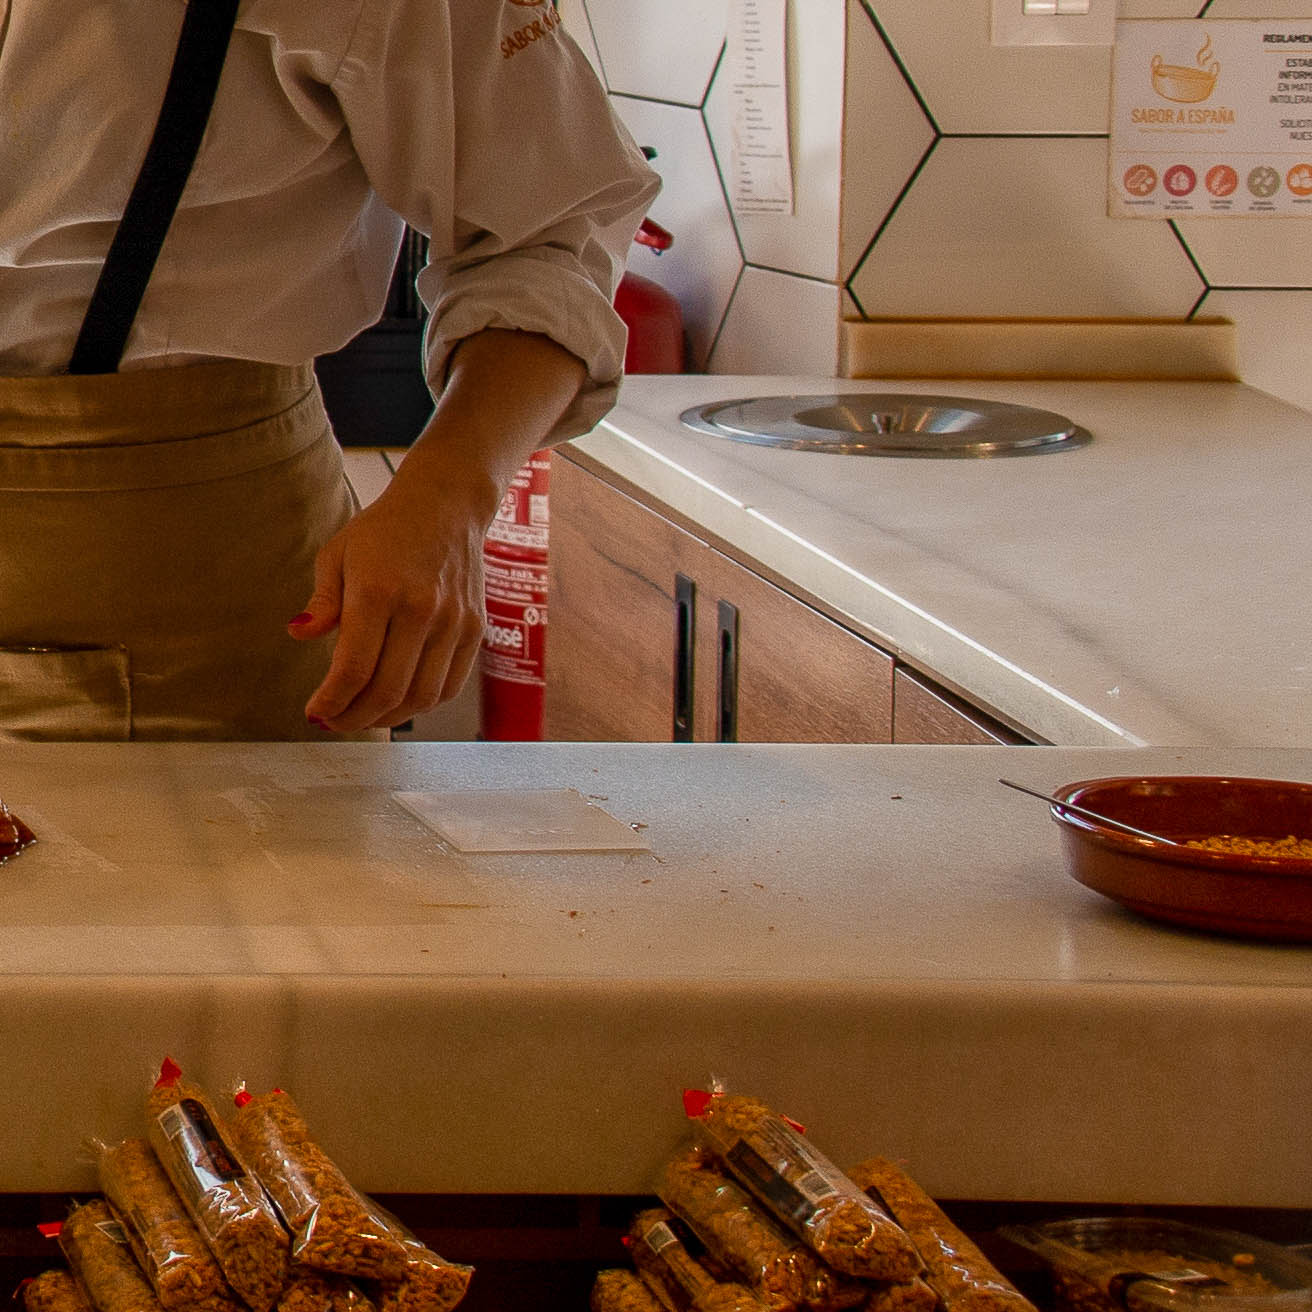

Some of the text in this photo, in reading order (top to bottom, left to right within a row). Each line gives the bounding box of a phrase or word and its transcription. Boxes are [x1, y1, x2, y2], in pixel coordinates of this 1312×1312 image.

[500, 20, 545, 59] SABOR
[1132, 106, 1236, 125] SABOR A ESPAÑA
